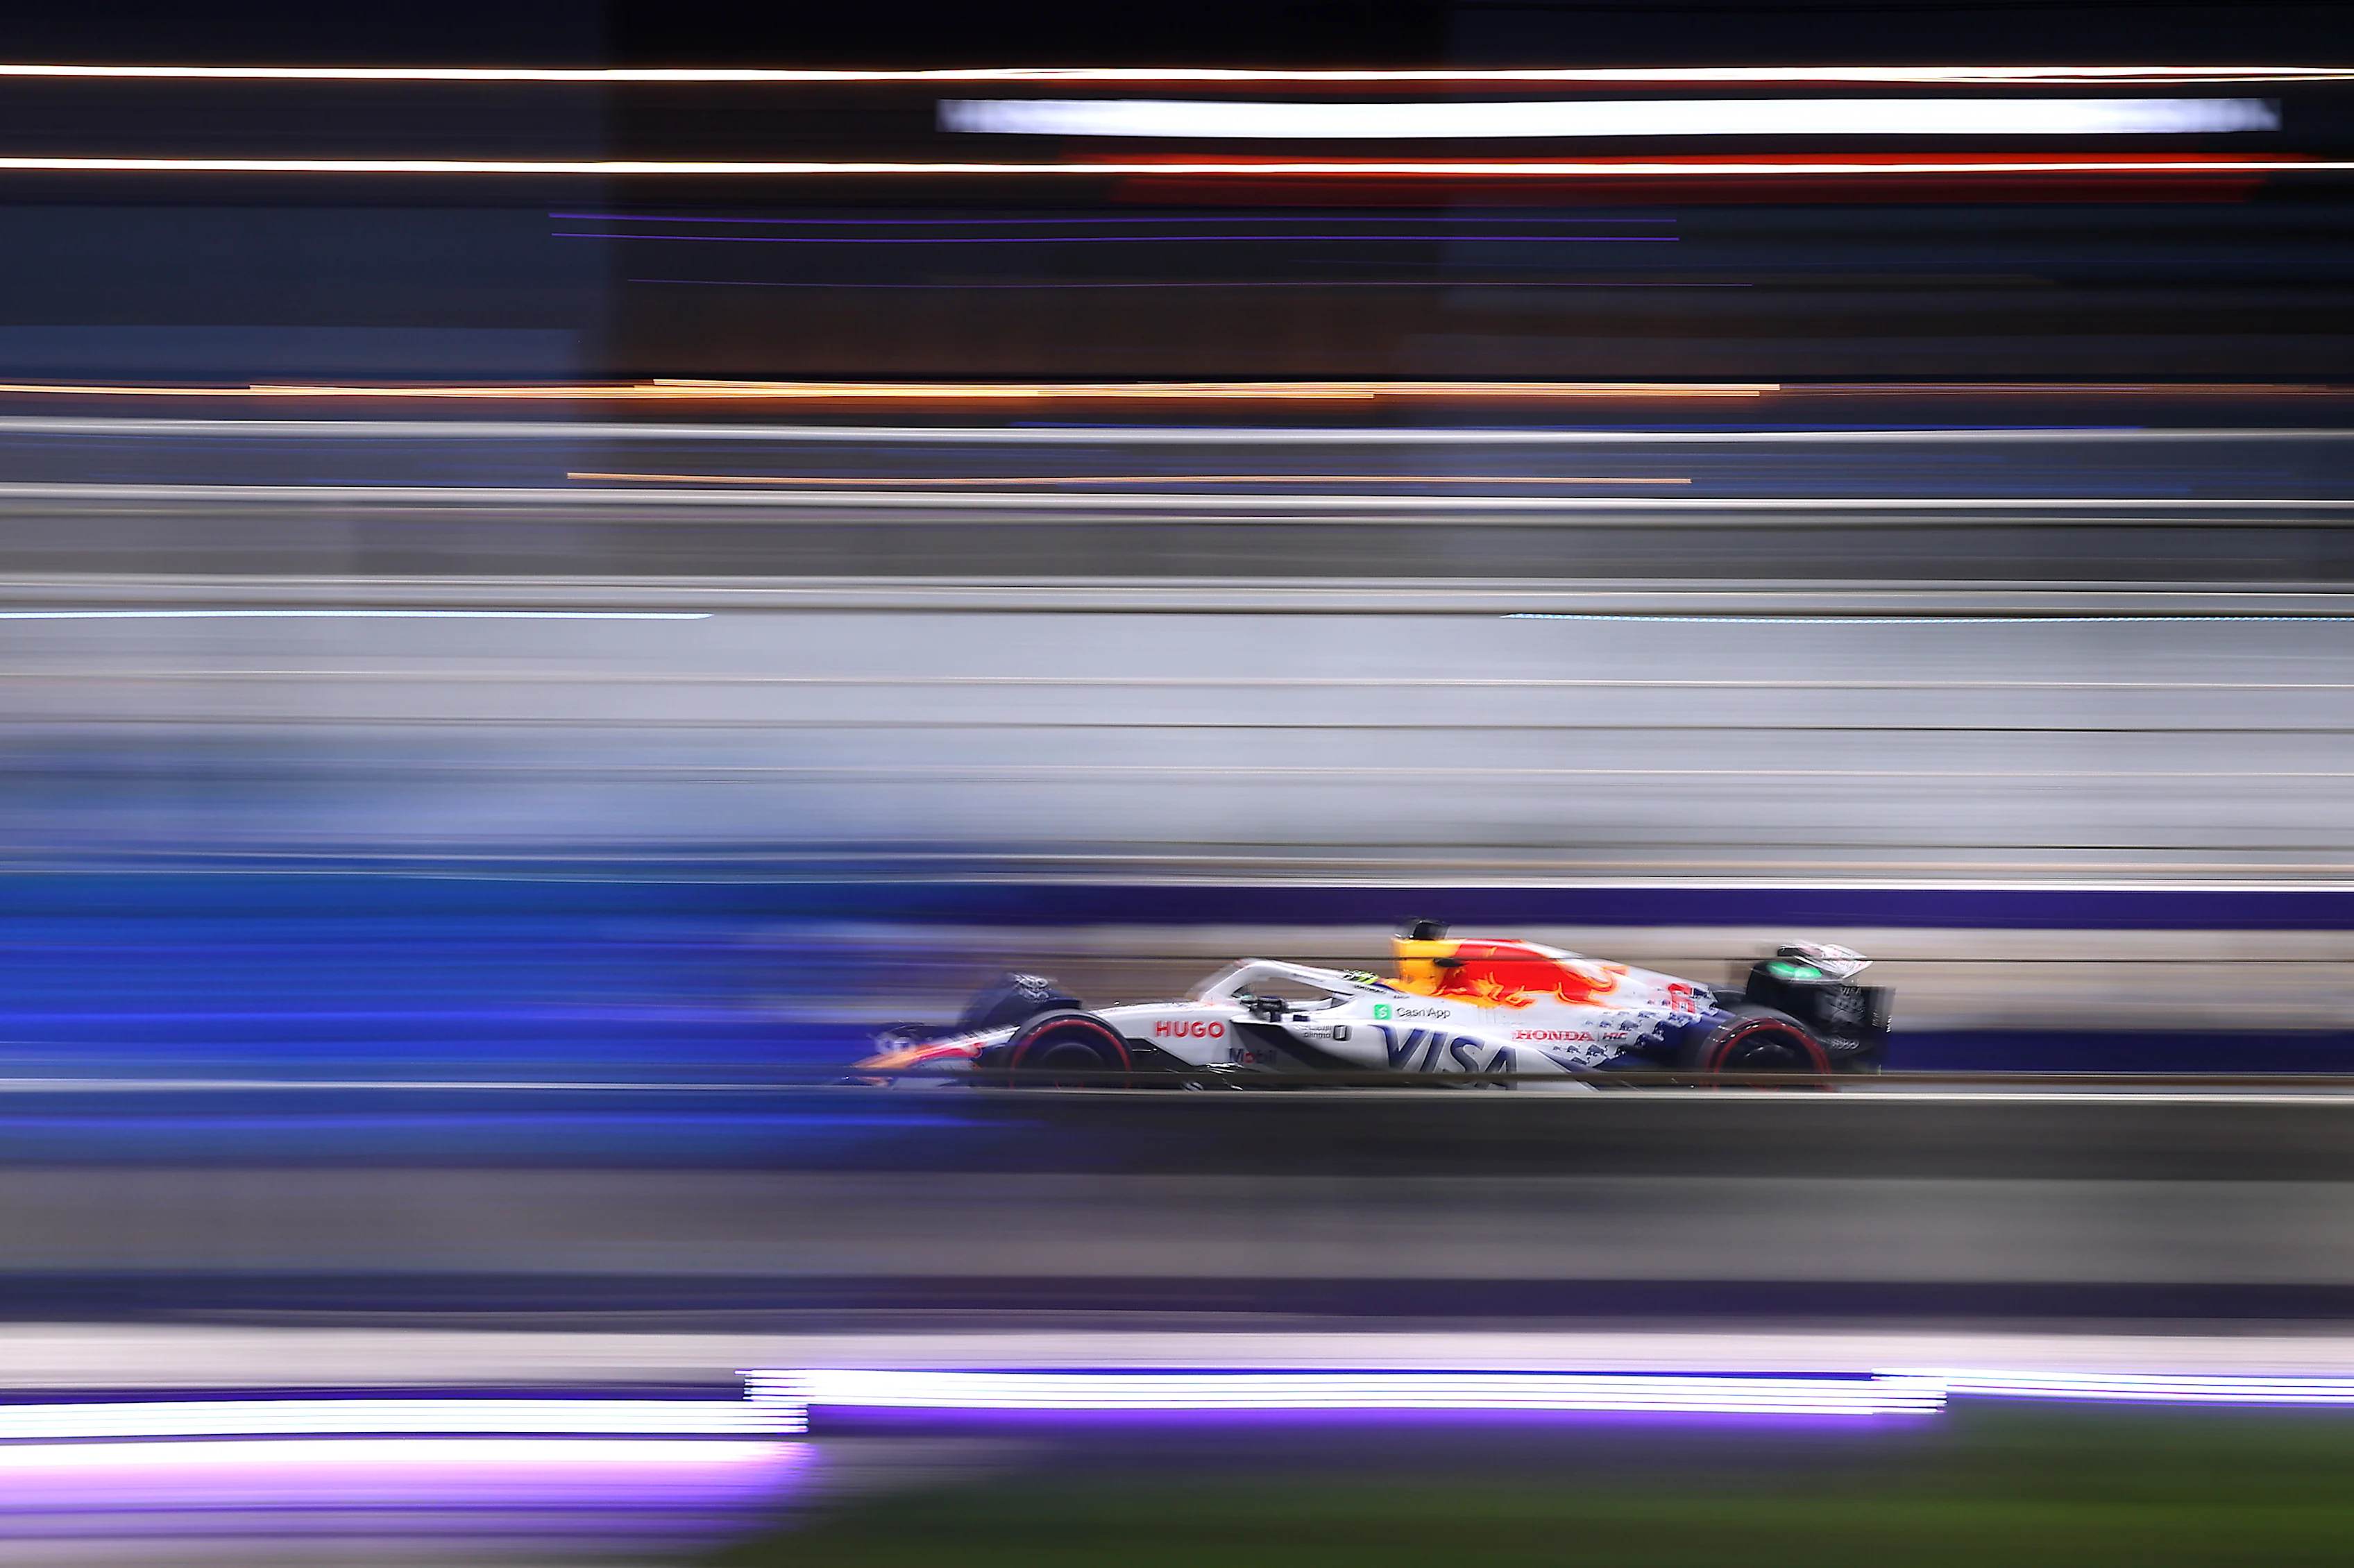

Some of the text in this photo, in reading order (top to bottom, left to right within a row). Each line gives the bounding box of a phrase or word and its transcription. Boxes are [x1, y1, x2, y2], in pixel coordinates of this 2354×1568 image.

[1396, 1007, 1451, 1019] Cash App
[1155, 1021, 1225, 1038] HUGO
[1514, 1030, 1595, 1041] HONDA
[1227, 1048, 1277, 1063] Mobil
[1368, 1024, 1518, 1090] VISA
